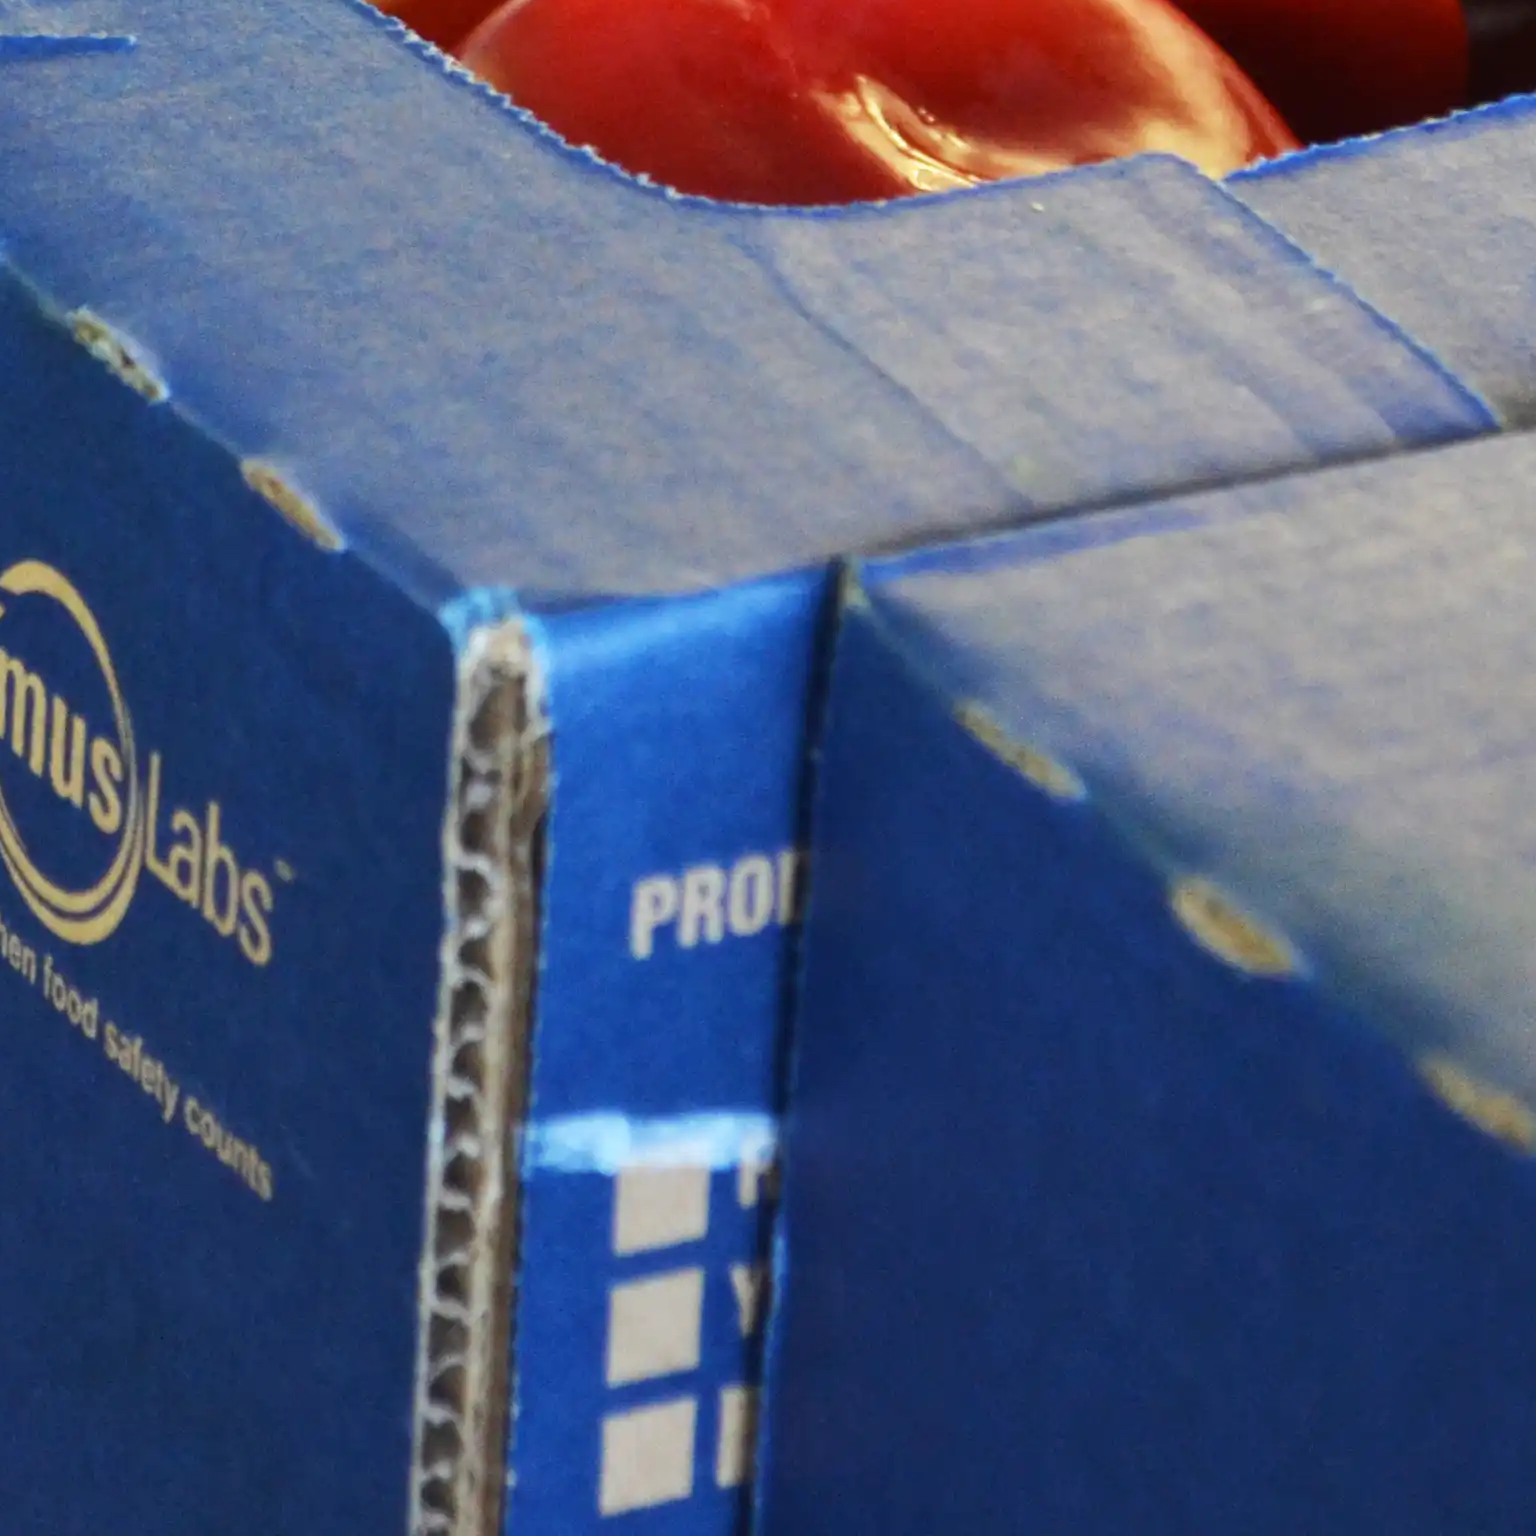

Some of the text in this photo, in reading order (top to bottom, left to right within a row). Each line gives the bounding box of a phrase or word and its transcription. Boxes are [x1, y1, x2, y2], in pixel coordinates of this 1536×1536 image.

[43, 953, 98, 1040] food
[104, 1021, 180, 1123] safety
[184, 1096, 273, 1201] counts
